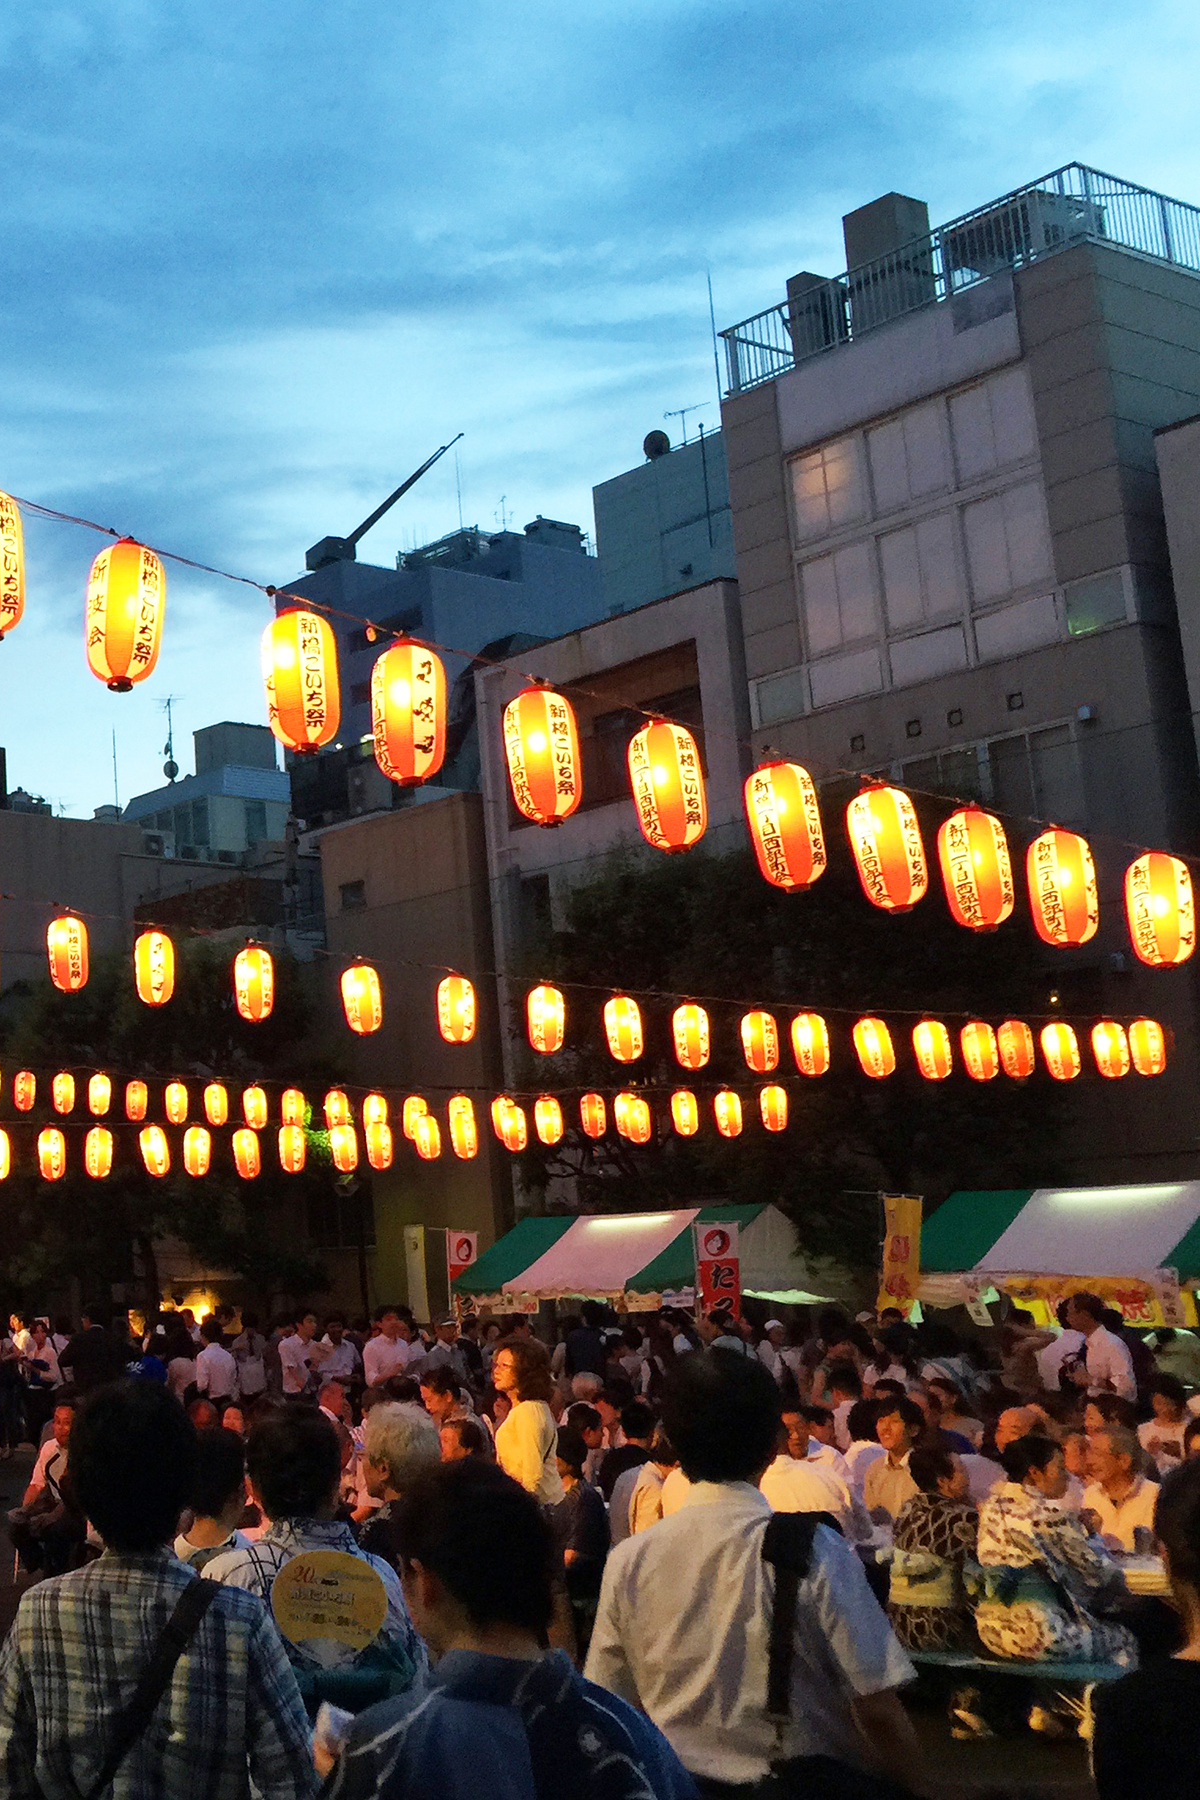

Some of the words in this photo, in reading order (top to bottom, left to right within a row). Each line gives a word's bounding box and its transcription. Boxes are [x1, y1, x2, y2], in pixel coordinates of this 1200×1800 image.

[132, 550, 159, 666] 新橋こいち祭
[299, 617, 325, 729] 新橋こいち祭
[549, 703, 575, 796] 新橋こいち祭
[676, 736, 702, 826] 新橋こいち祭
[800, 776, 826, 866] 新橋こいち祭
[899, 801, 926, 887] 新橋こいち祭
